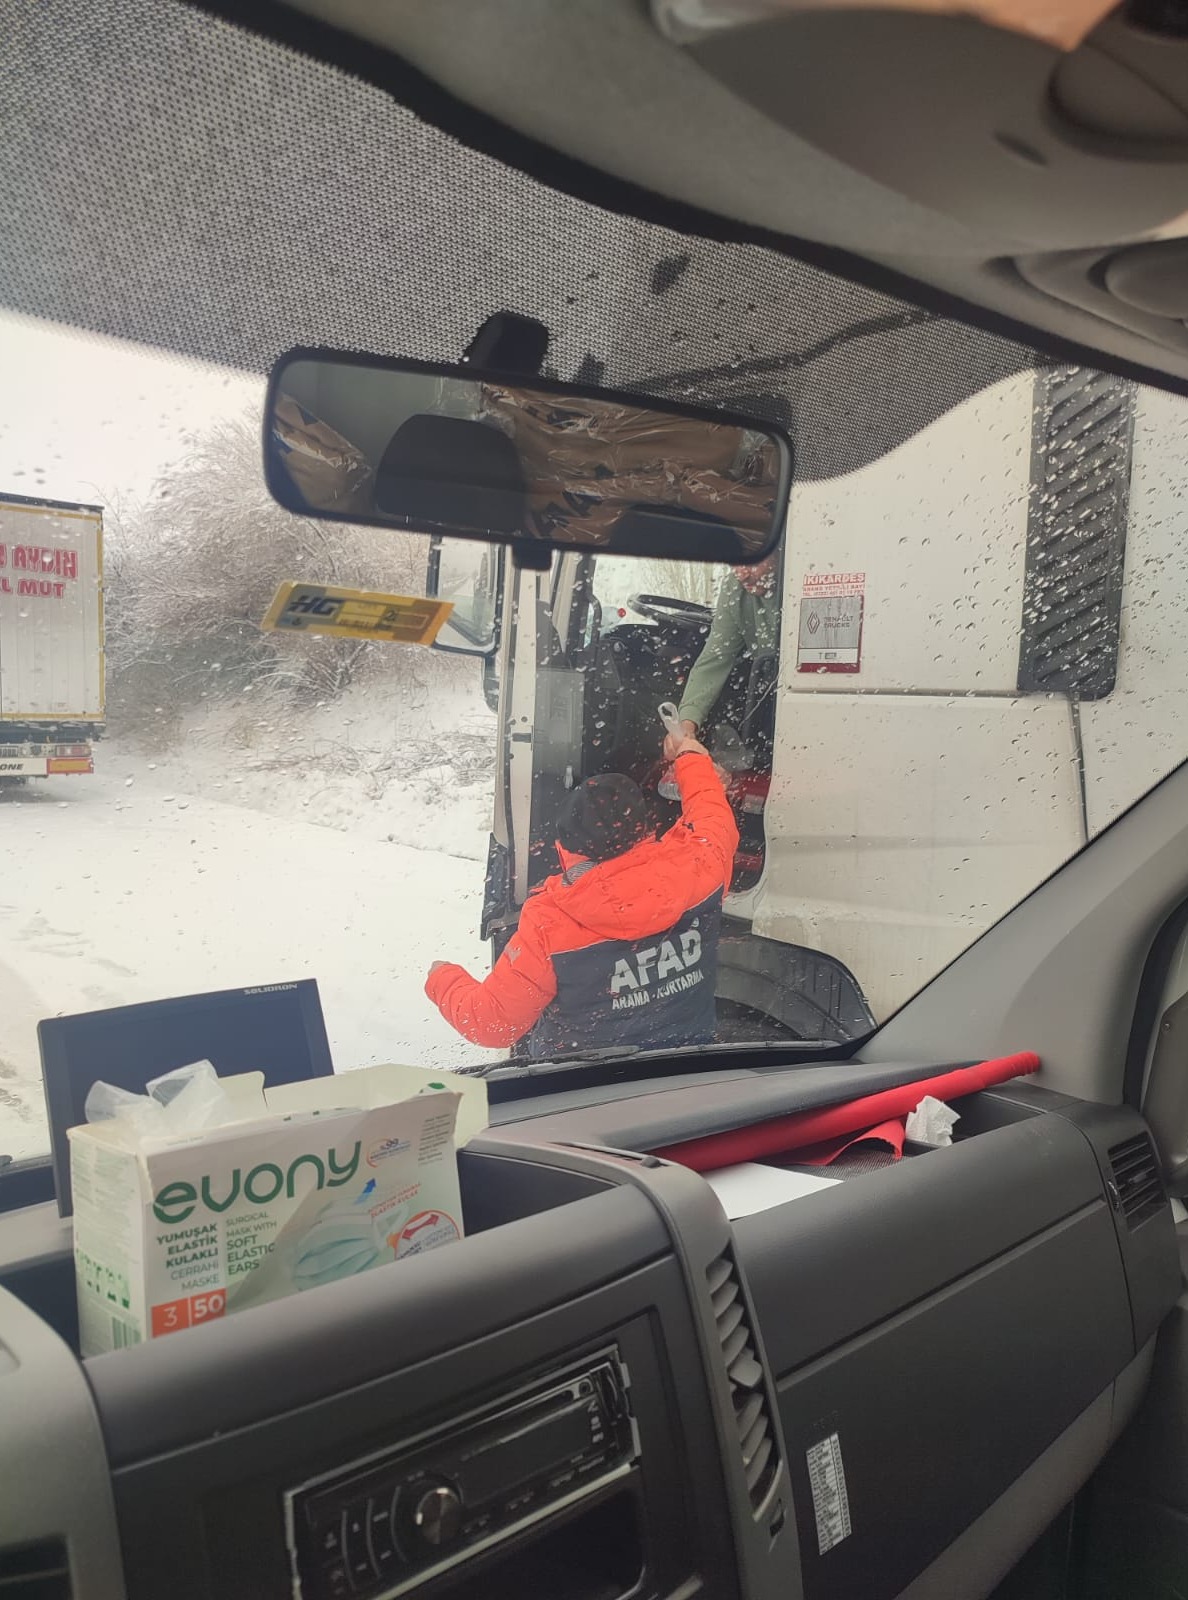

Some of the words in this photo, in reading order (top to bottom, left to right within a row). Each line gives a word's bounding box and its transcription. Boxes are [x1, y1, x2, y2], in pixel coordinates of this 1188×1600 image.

[18, 579, 65, 598] MUT
[610, 929, 703, 995] AFAD
[612, 990, 651, 1010] ARAMA
[656, 969, 704, 999] KURTARMA
[153, 1141, 362, 1224] evony
[226, 1211, 269, 1227] SURGICAL
[226, 1227, 252, 1238] MASK
[253, 1220, 277, 1232] WITH
[157, 1222, 218, 1245] YUMUŞAK
[227, 1234, 258, 1251] SOFT
[168, 1234, 218, 1255] ELASTİK
[227, 1242, 276, 1262] ELASTIC
[166, 1247, 219, 1268] KULAKLI
[228, 1259, 260, 1275] EARS
[181, 1273, 220, 1290] MASKE
[163, 1306, 178, 1327] 3
[194, 1293, 224, 1319] 50
